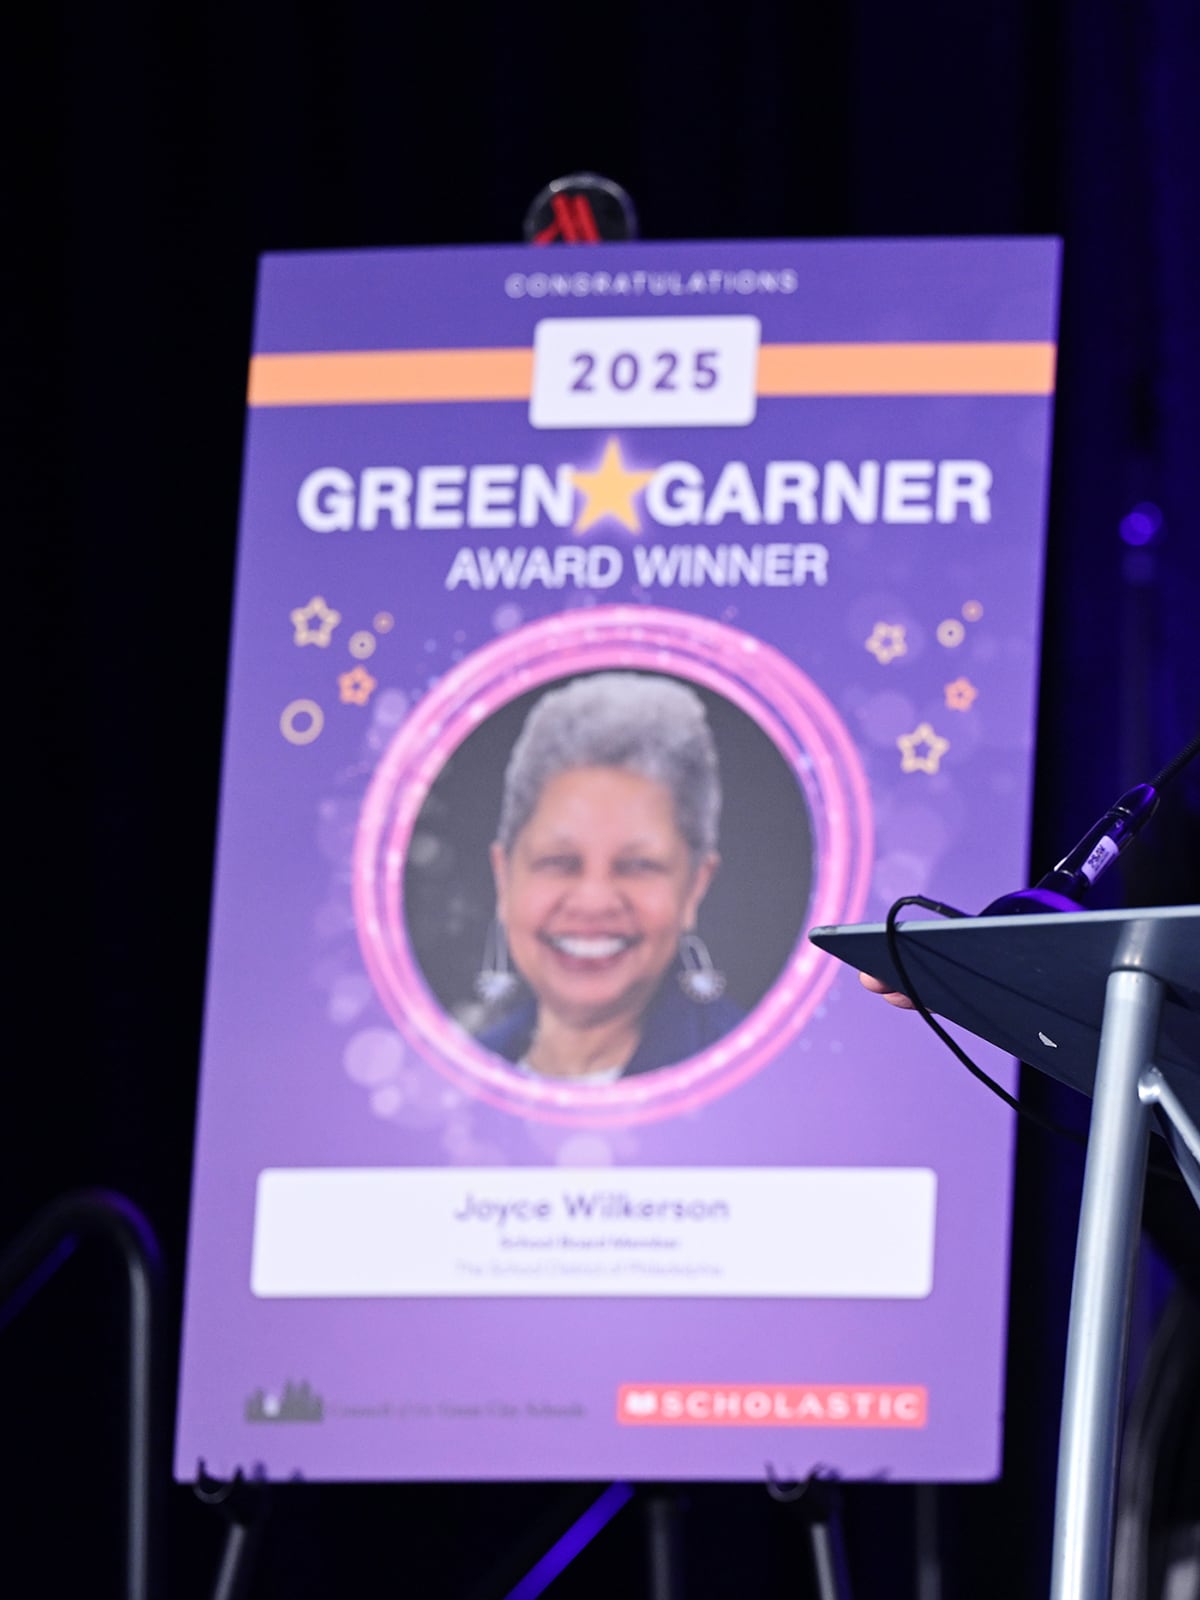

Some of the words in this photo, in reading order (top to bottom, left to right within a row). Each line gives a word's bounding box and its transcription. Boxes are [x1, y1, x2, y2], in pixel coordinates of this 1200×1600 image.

[504, 268, 799, 299] CONGRATULATIONS
[570, 351, 718, 393] 2025
[297, 463, 577, 533] GREEN
[646, 459, 993, 527] GARNER
[445, 545, 623, 591] AWARD
[633, 543, 829, 588] WINNER
[453, 1192, 552, 1228] Joyce
[561, 1191, 731, 1220] Wilkerson
[660, 1391, 921, 1420] SCHOLASTIC
